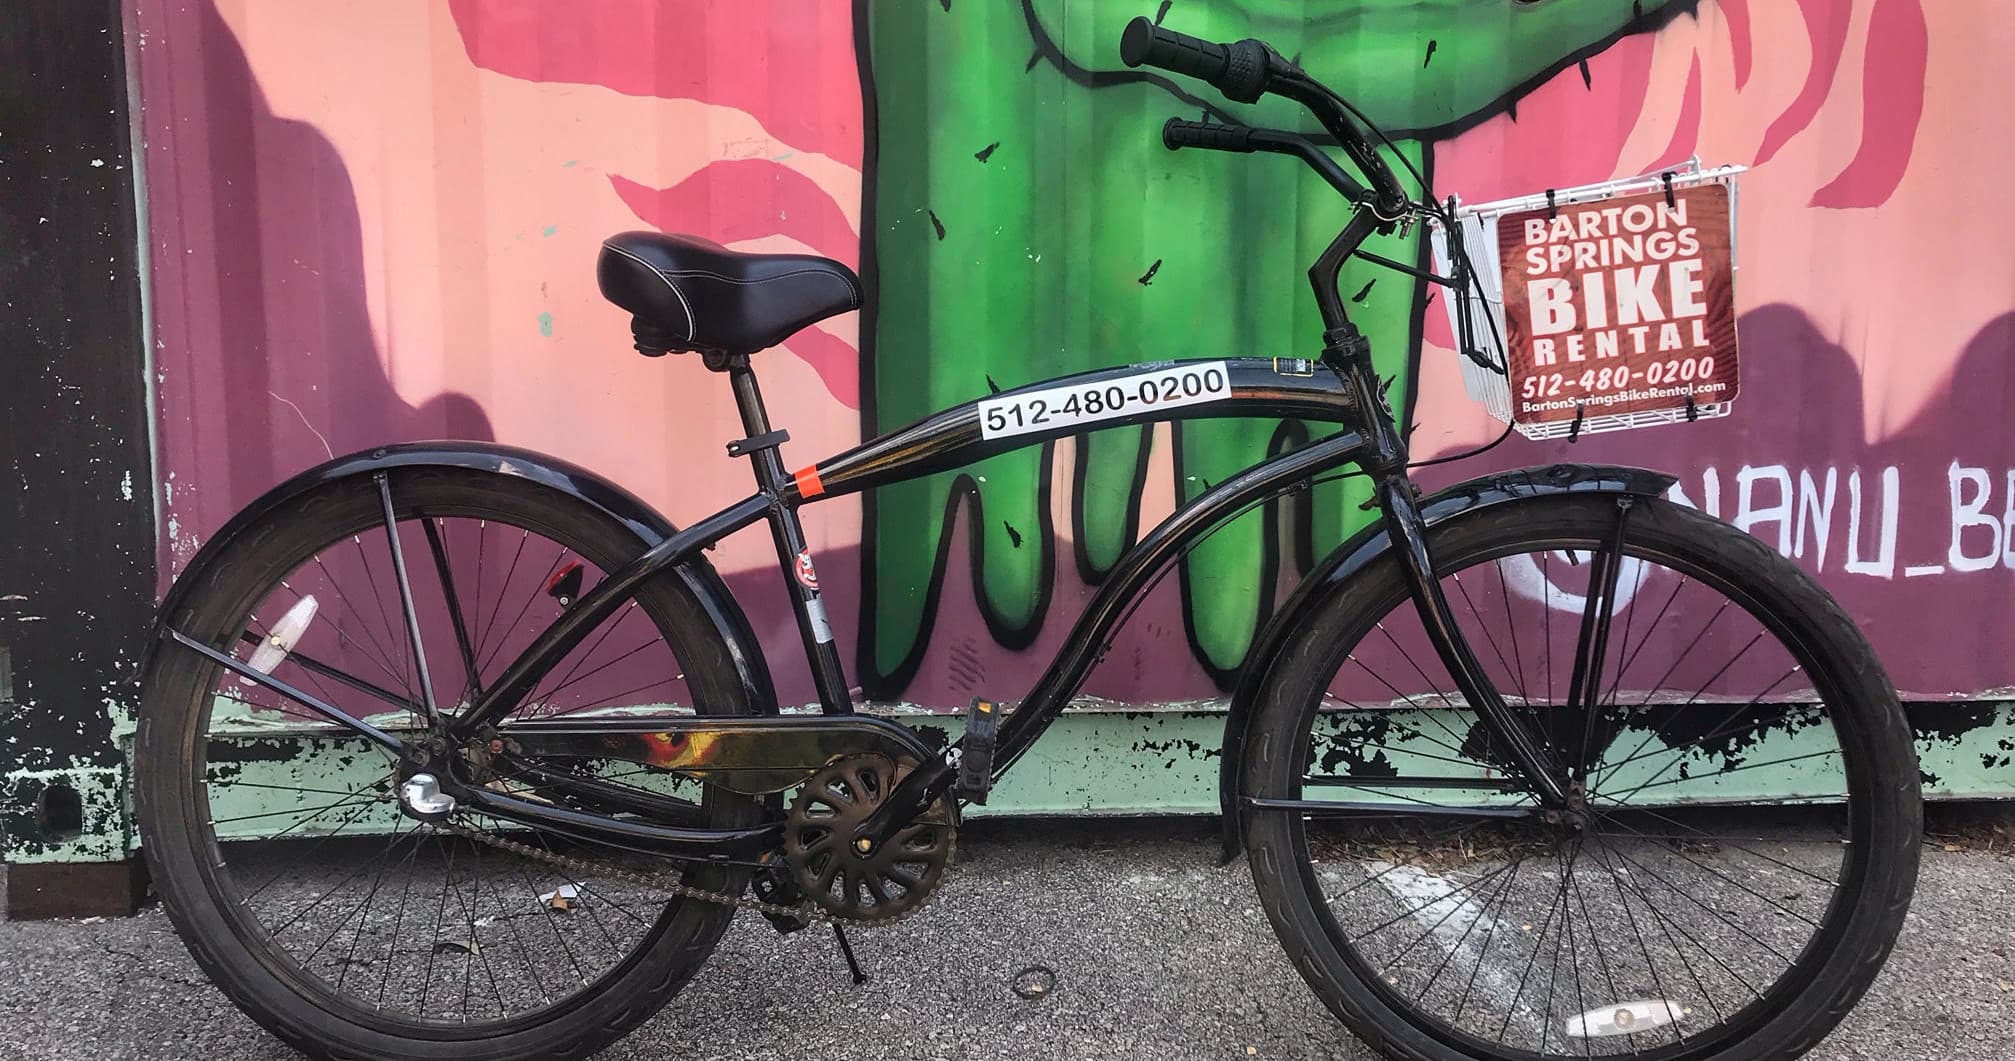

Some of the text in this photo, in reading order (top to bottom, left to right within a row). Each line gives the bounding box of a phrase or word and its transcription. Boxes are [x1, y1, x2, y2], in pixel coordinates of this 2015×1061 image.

[1524, 198, 1688, 246] BARTON
[1526, 227, 1700, 275] SPRINGS
[1527, 258, 1708, 337] BIKE
[1533, 319, 1710, 367] RENTAL
[986, 369, 1225, 432] 512-480-0200
[1522, 356, 1715, 399] 512-480-0200
